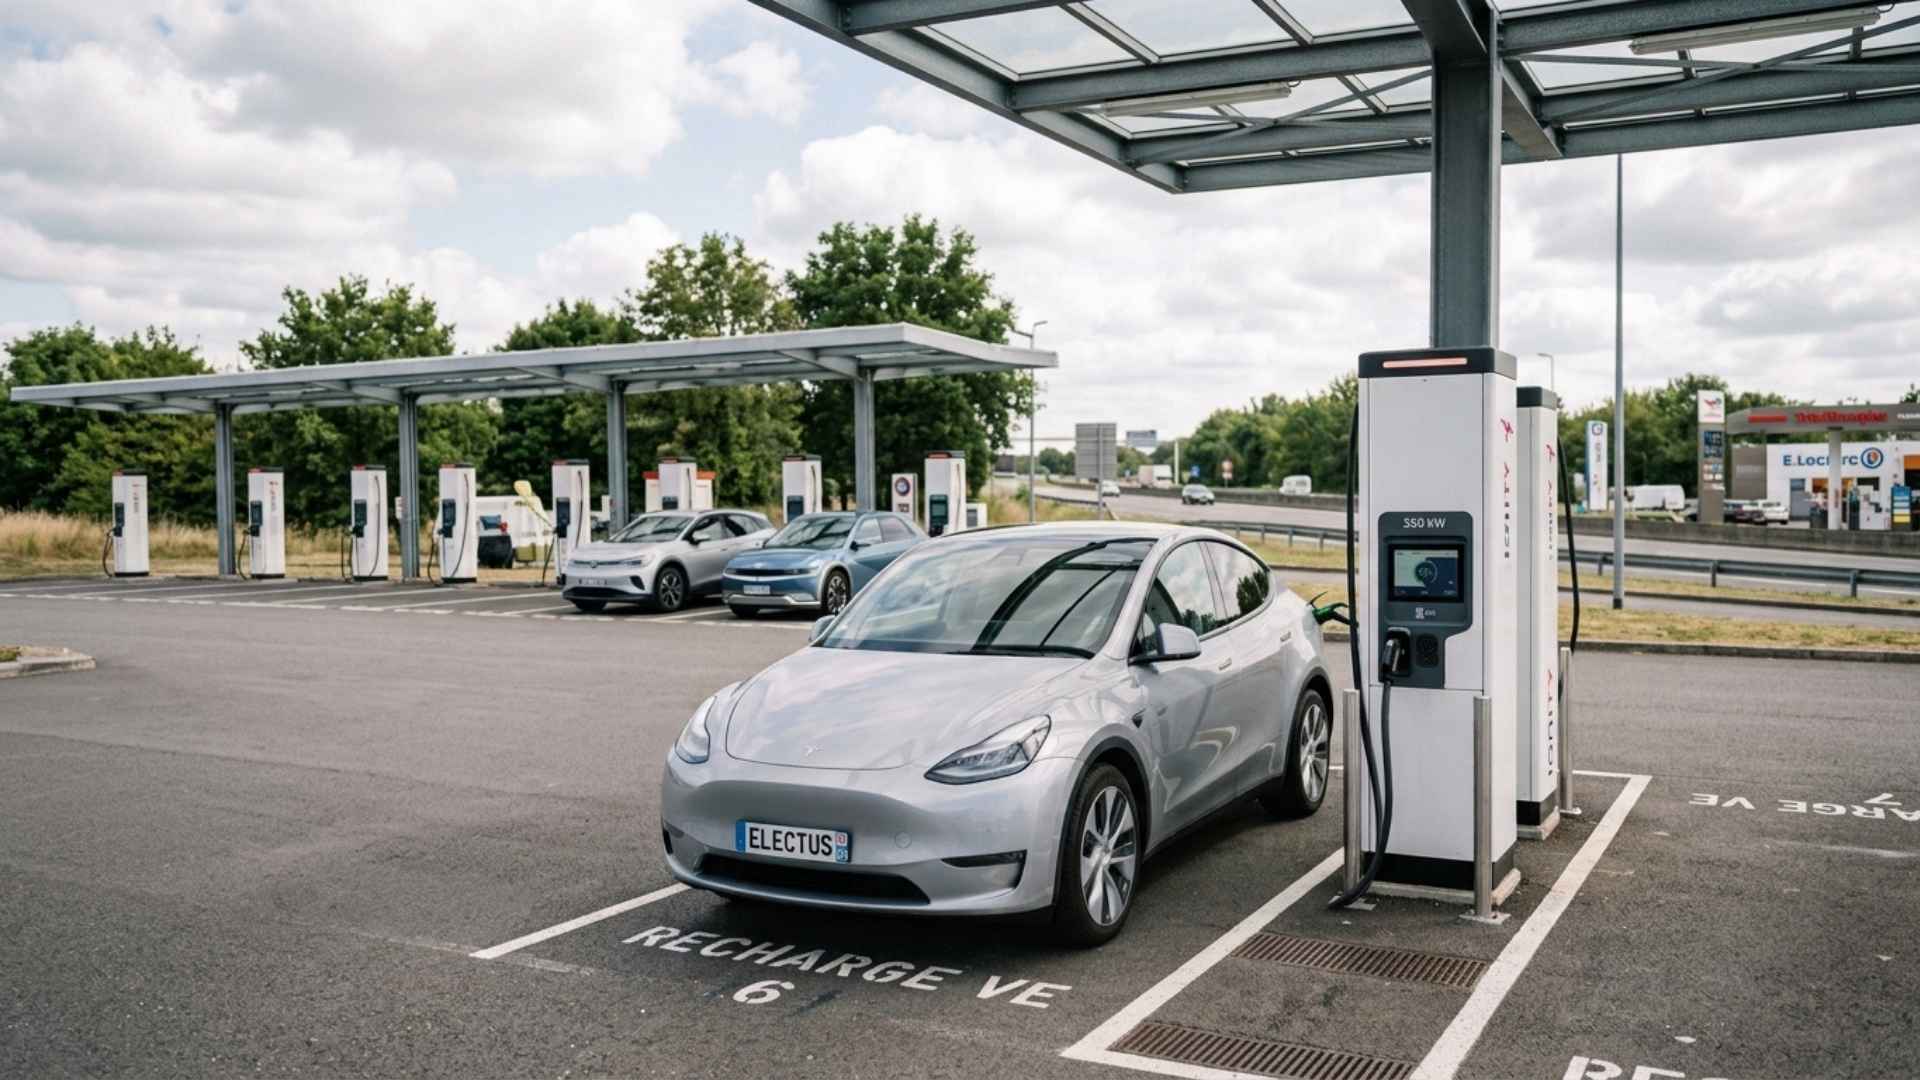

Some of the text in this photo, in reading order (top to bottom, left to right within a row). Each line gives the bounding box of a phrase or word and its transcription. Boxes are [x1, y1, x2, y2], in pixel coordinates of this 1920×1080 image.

[1688, 792, 1756, 811] VE
[1864, 792, 1902, 806] 7
[749, 827, 833, 857] ELECTUS
[621, 925, 1072, 1009] RECHARGE VE
[732, 979, 795, 1004] 6
